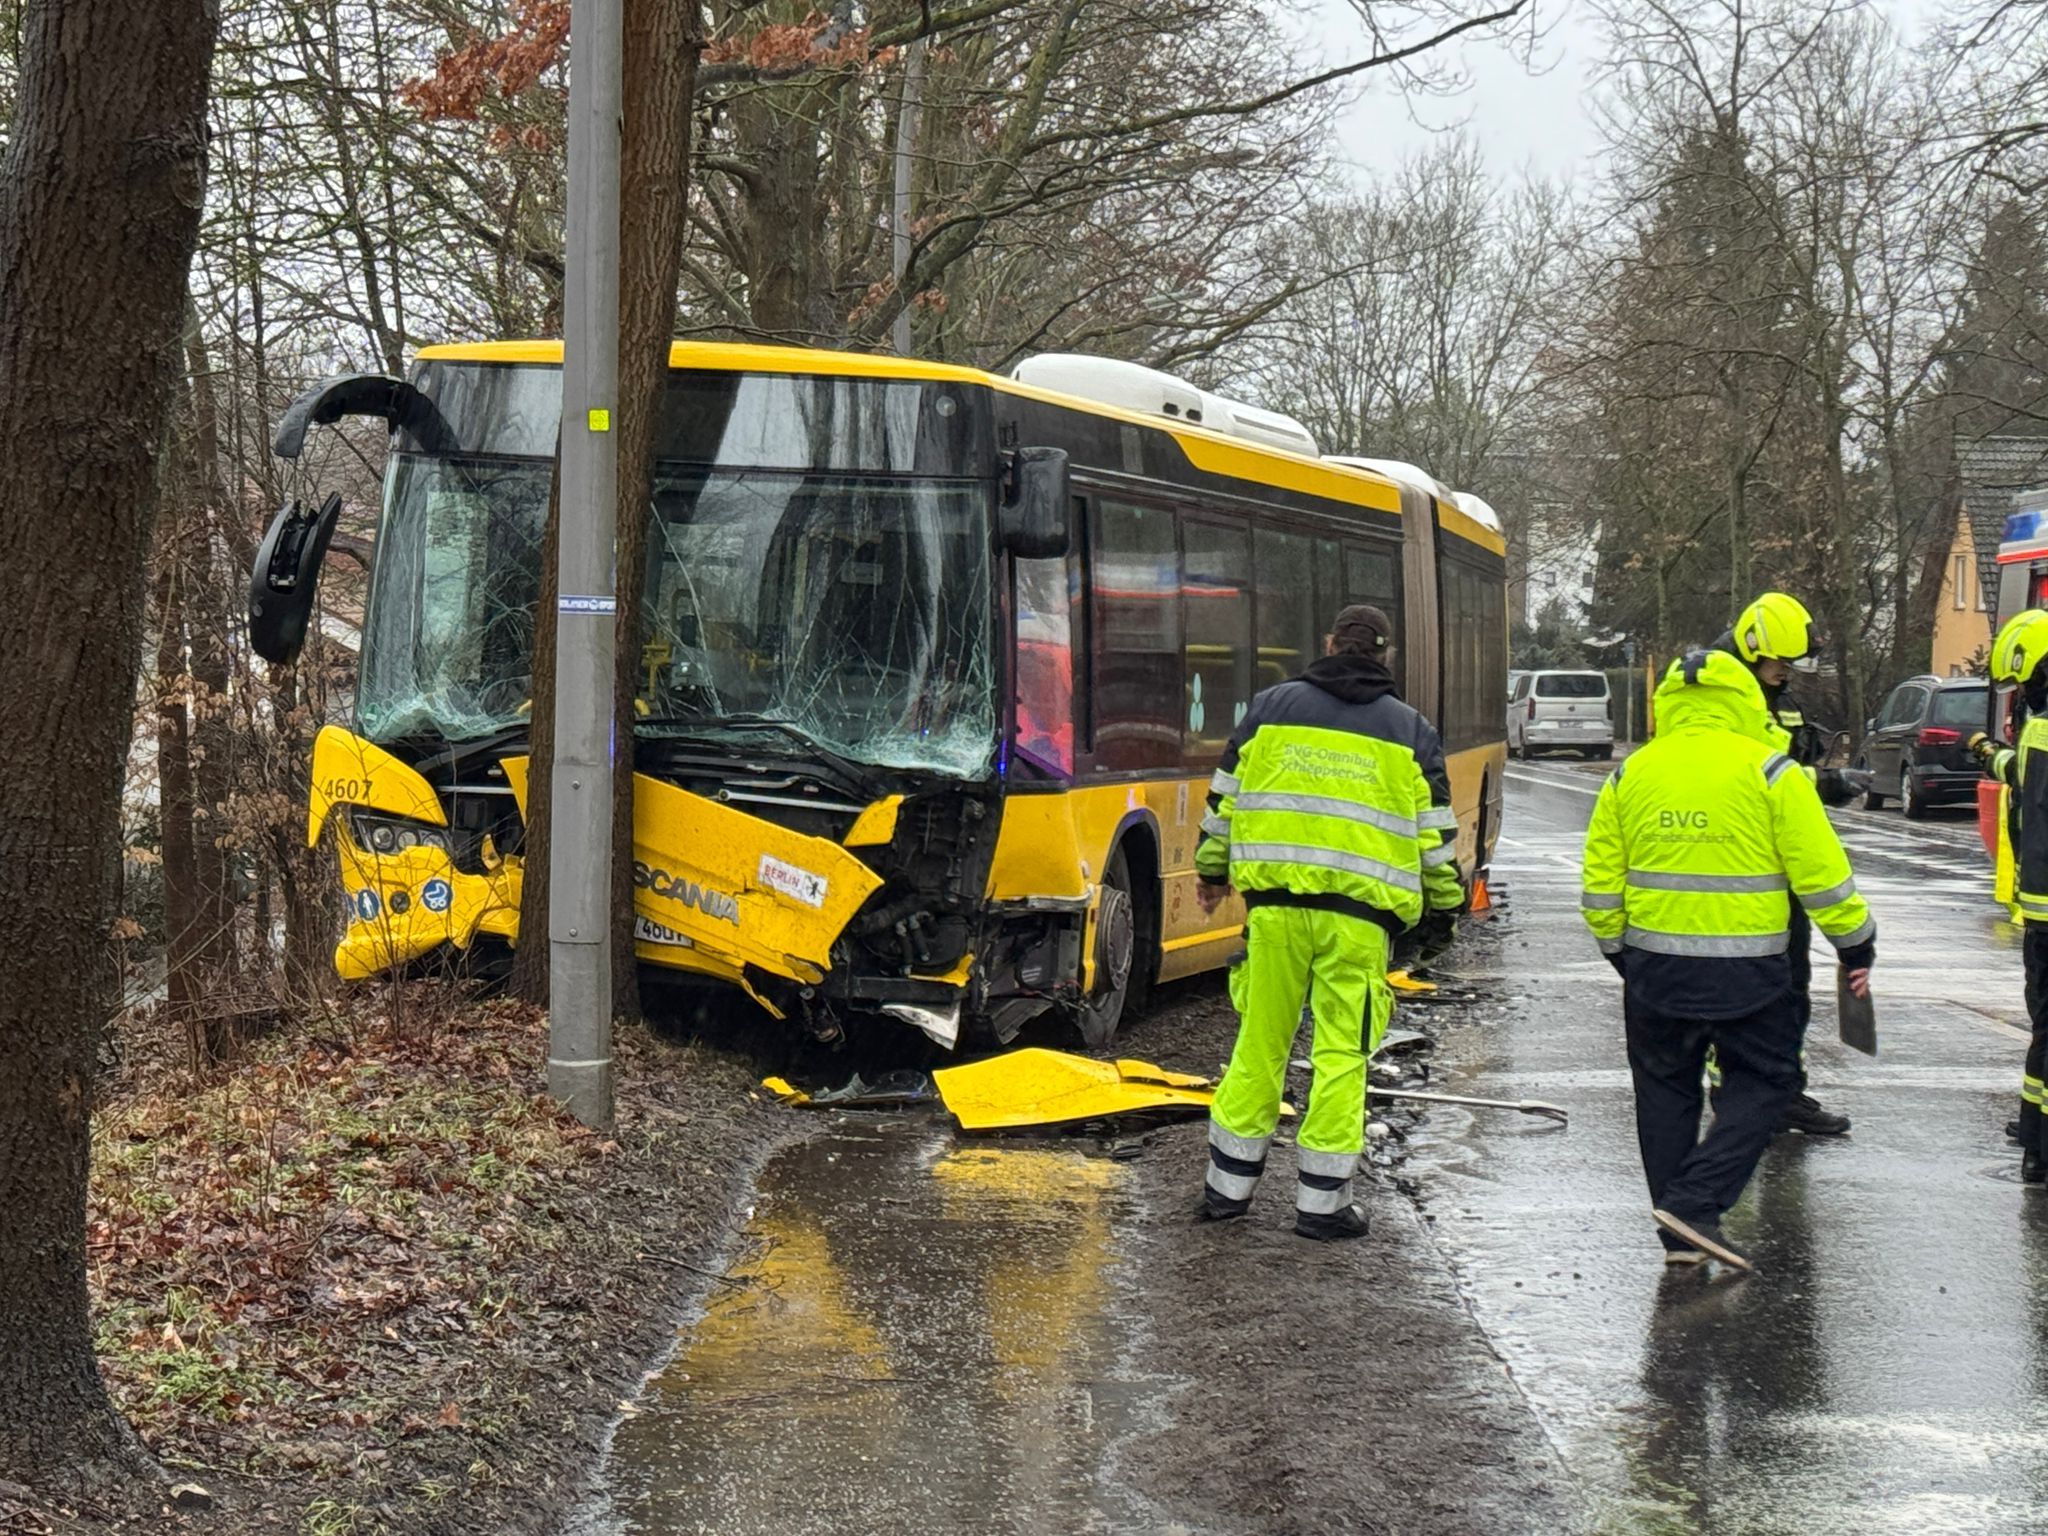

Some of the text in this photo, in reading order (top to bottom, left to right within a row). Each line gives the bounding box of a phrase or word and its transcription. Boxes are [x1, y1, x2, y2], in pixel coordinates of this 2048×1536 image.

[325, 778, 373, 800] 4607
[1660, 809, 1708, 828] BVG
[764, 864, 801, 888] BERLIN
[632, 860, 739, 926] SCANIA
